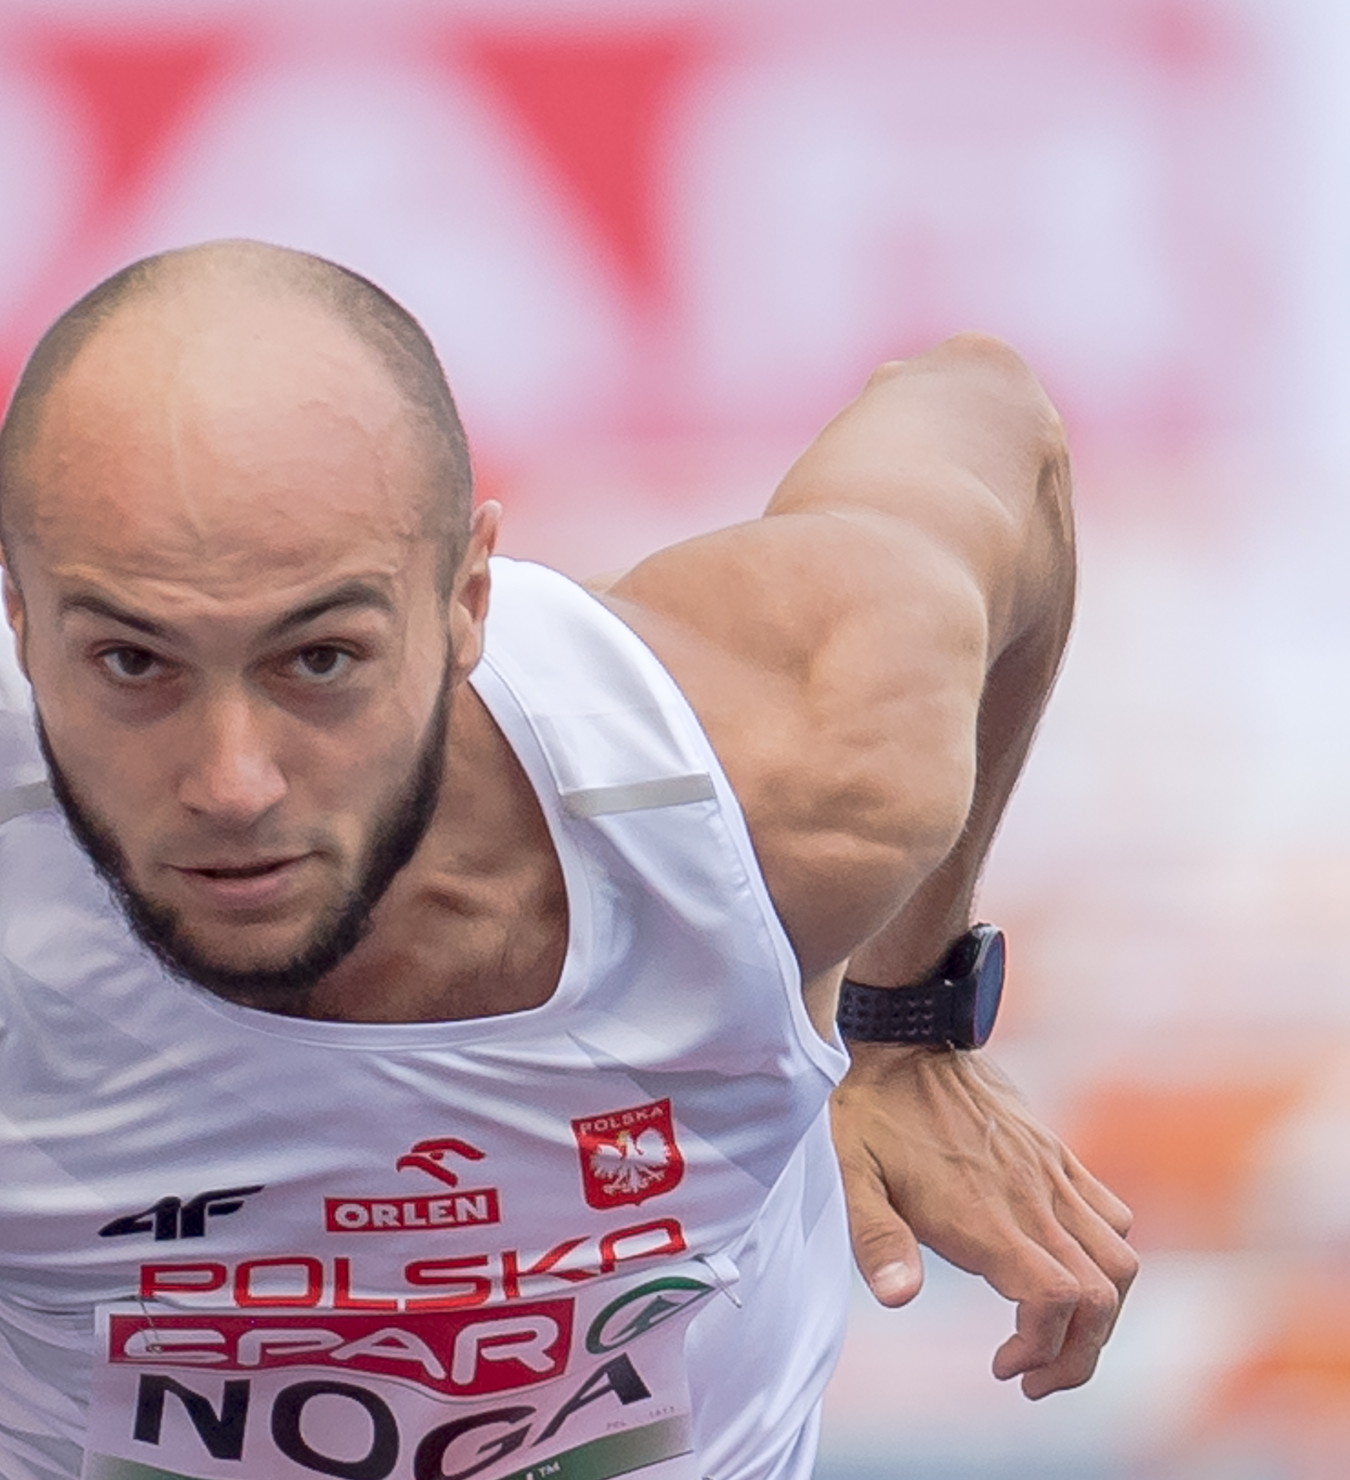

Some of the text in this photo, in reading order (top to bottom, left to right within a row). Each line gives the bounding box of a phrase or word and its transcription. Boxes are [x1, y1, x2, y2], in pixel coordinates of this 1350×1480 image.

[579, 1106, 664, 1136] POLSKA
[98, 1185, 264, 1241] 4F
[334, 1194, 489, 1229] ORLEN
[139, 1218, 687, 1312] POLSKA
